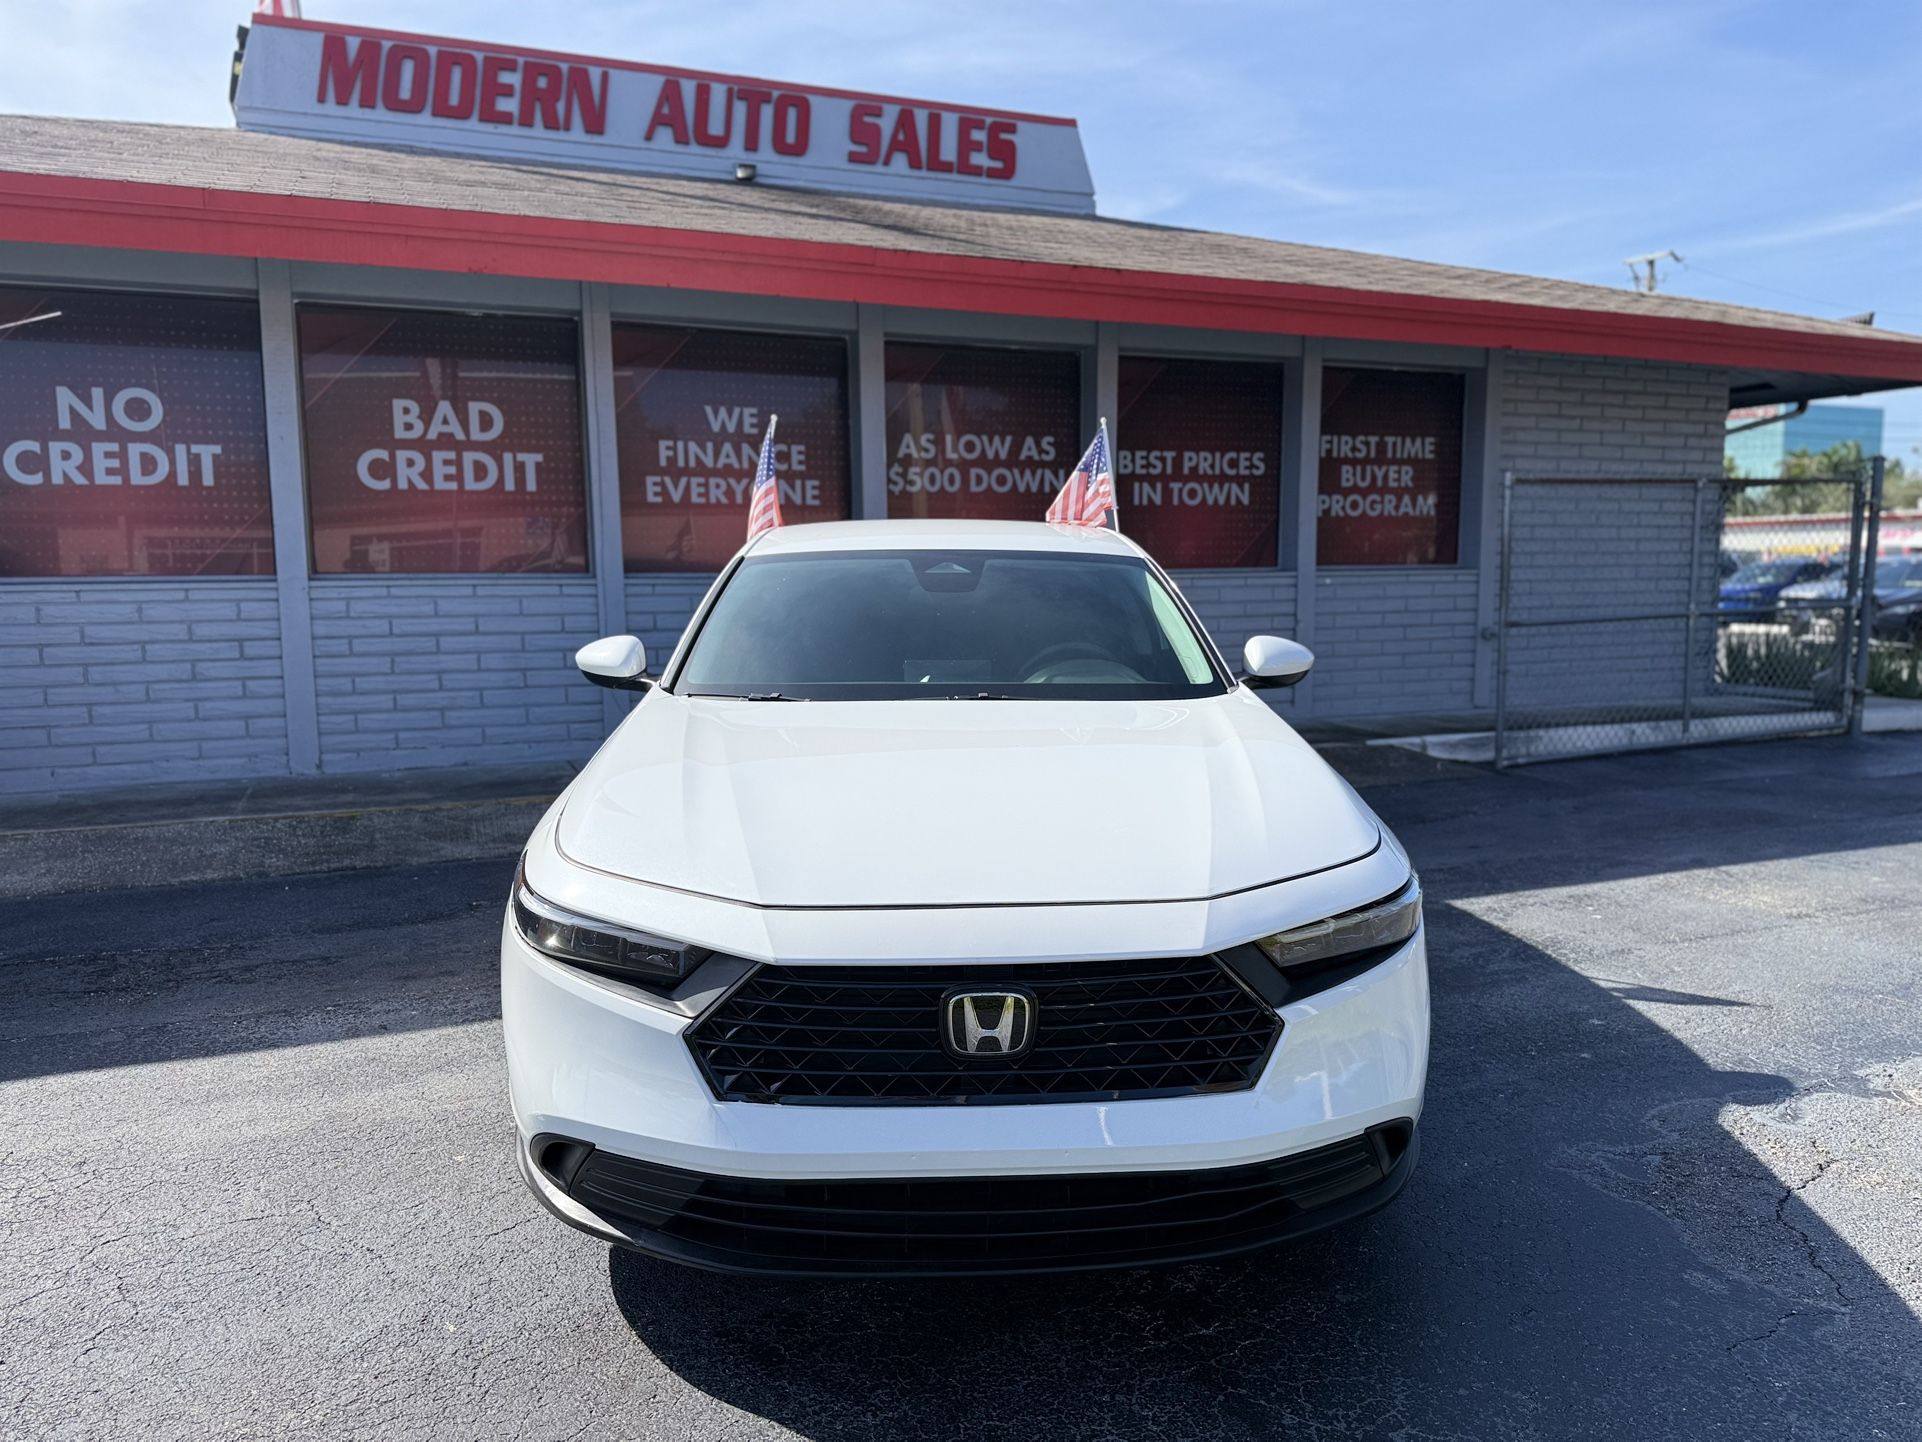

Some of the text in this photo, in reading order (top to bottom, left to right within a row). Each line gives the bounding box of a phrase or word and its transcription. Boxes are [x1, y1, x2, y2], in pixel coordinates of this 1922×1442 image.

[316, 33, 1018, 180] MODERN AUTO SALES
[55, 385, 164, 433] NO
[392, 398, 505, 442] BAD
[704, 405, 760, 435] WE
[658, 439, 807, 472] FINANCE
[897, 433, 1057, 461] AS LOW AS
[1320, 434, 1436, 459] FIRST TIME
[2, 440, 223, 487] CREDIT
[356, 448, 544, 493] CREDIT
[1118, 450, 1266, 476] BEST PRICES
[1341, 465, 1414, 488] BUYER
[645, 475, 822, 506] EVERYNE
[888, 463, 1066, 496] $500 DOWN
[1133, 482, 1250, 507] IN TOWN
[1317, 493, 1437, 517] PROGRAM
